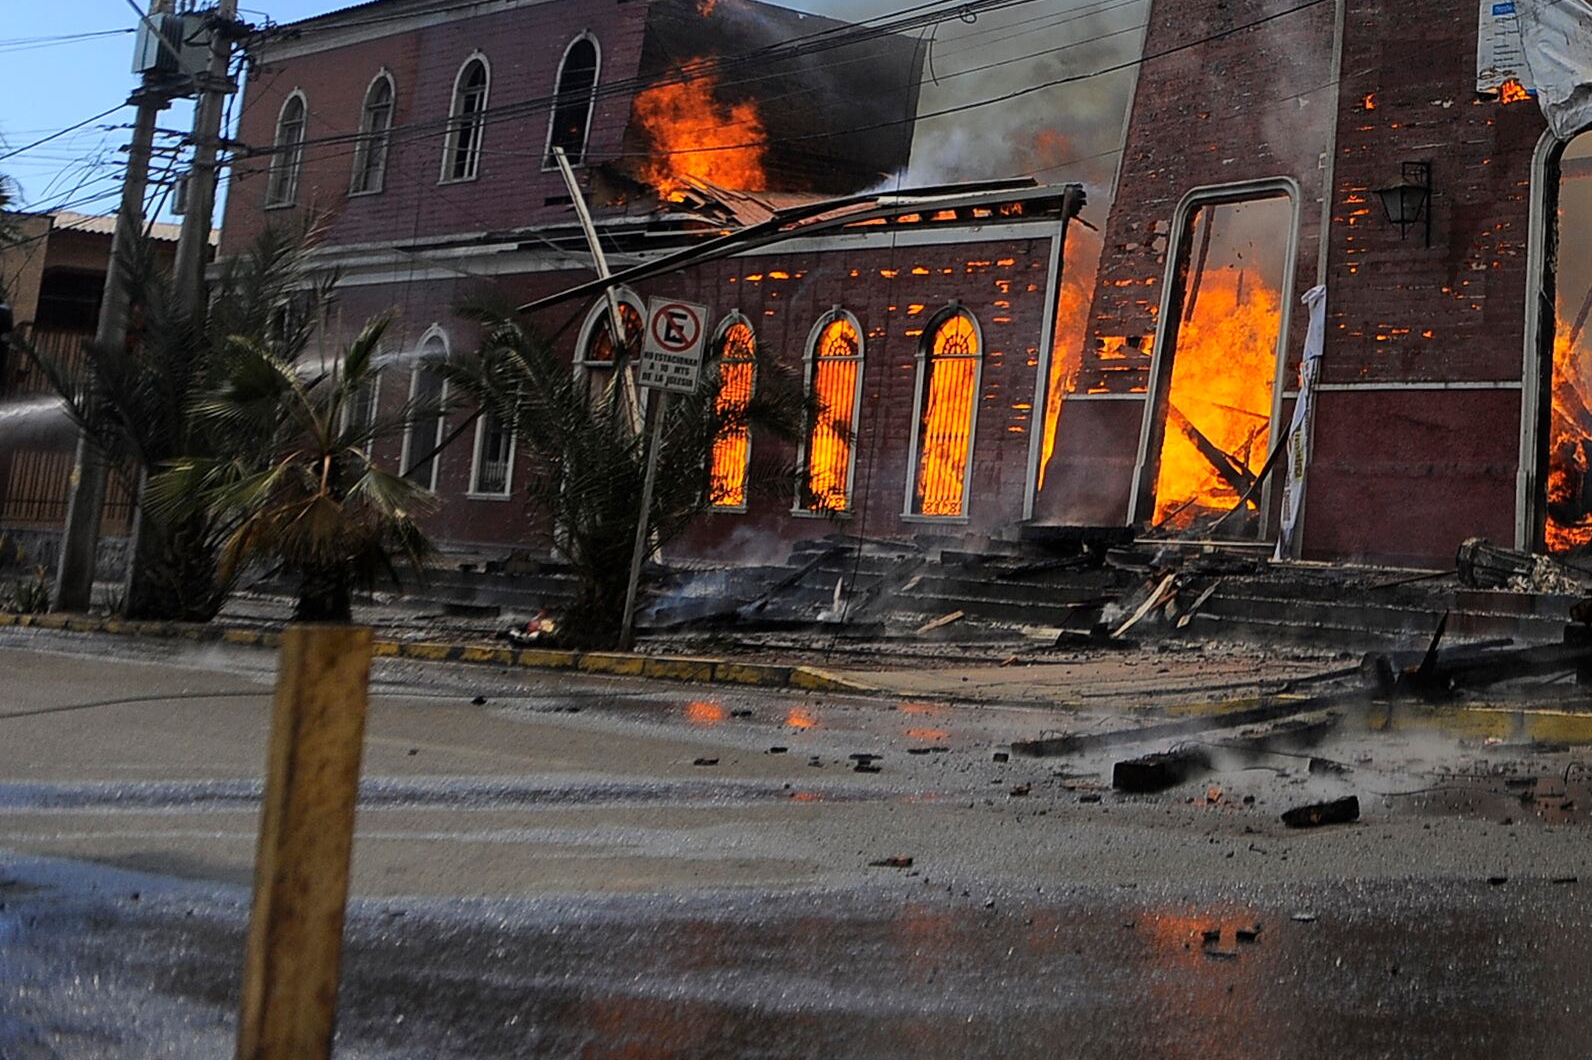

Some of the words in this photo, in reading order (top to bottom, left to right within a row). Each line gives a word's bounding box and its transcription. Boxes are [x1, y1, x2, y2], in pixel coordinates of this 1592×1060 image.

[655, 352, 698, 366] ESTACIONAR
[648, 361, 654, 369] A
[660, 363, 669, 372] 10
[674, 366, 690, 376] MTS
[642, 372, 651, 381] DE
[654, 374, 664, 382] LA
